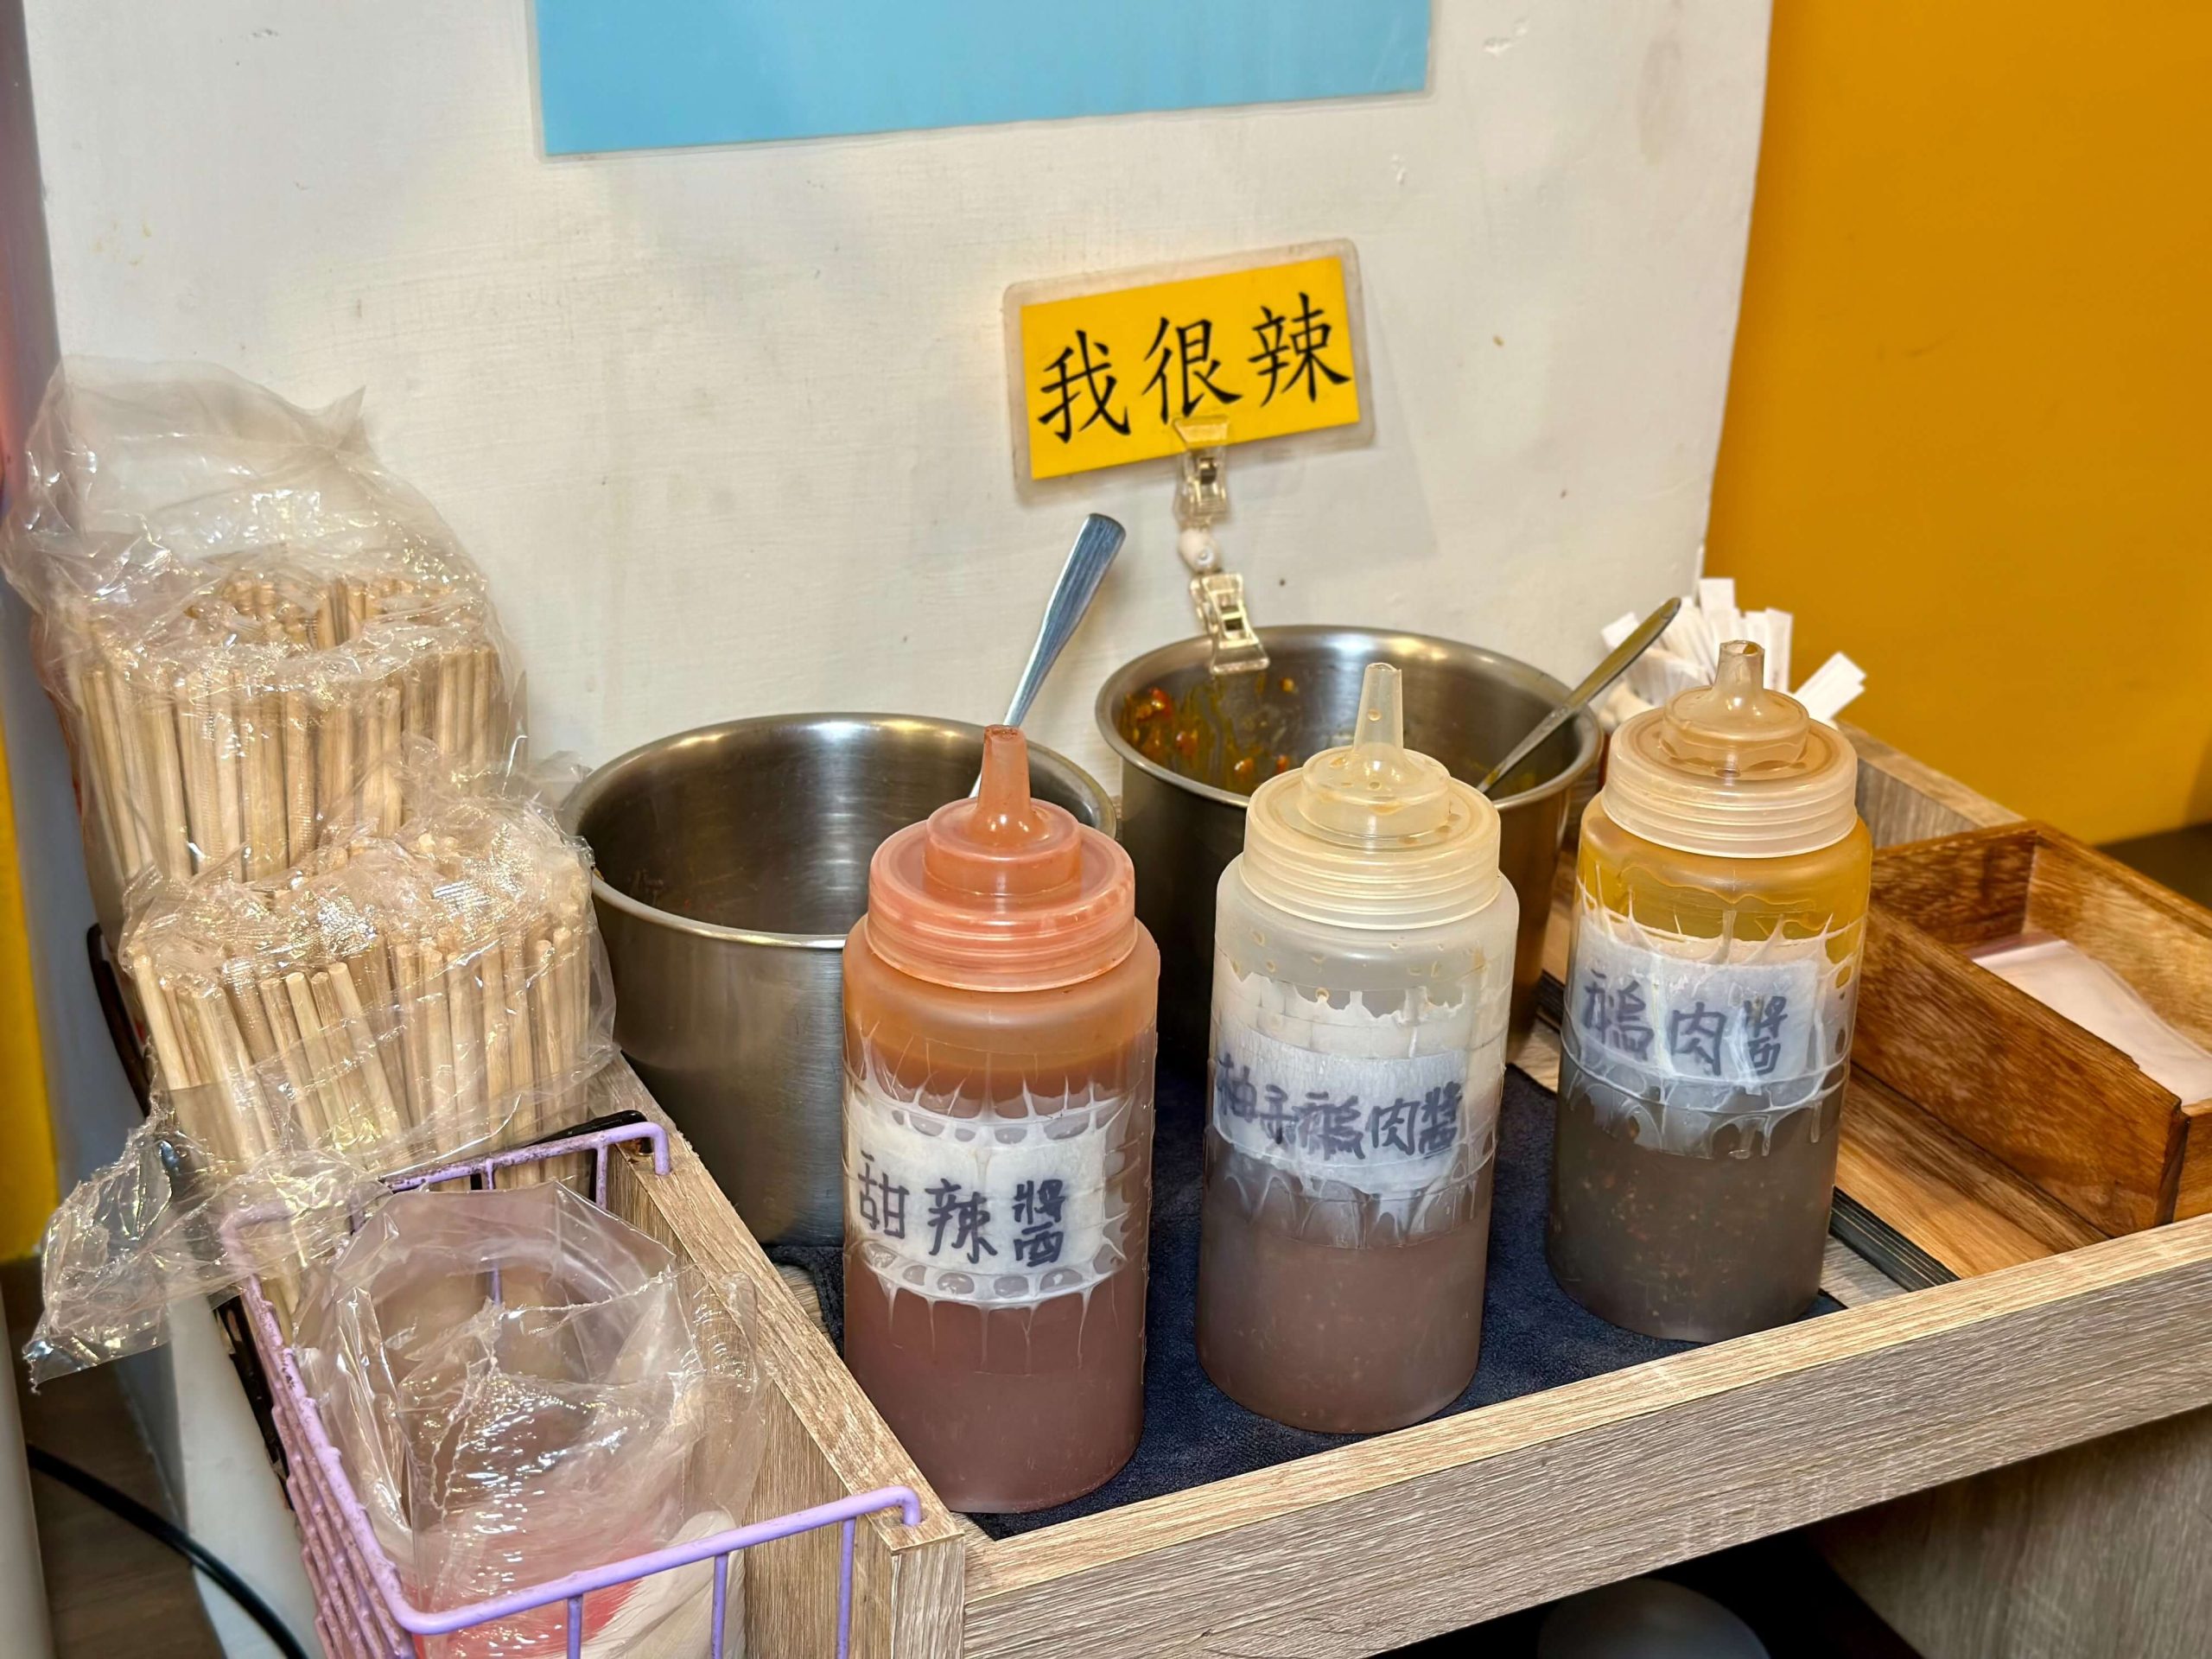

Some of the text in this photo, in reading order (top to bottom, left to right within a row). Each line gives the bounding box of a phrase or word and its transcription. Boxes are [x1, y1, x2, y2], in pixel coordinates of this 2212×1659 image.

[1039, 292, 1351, 443] 我很辣
[858, 1150, 1066, 1267] 甜辣醬
